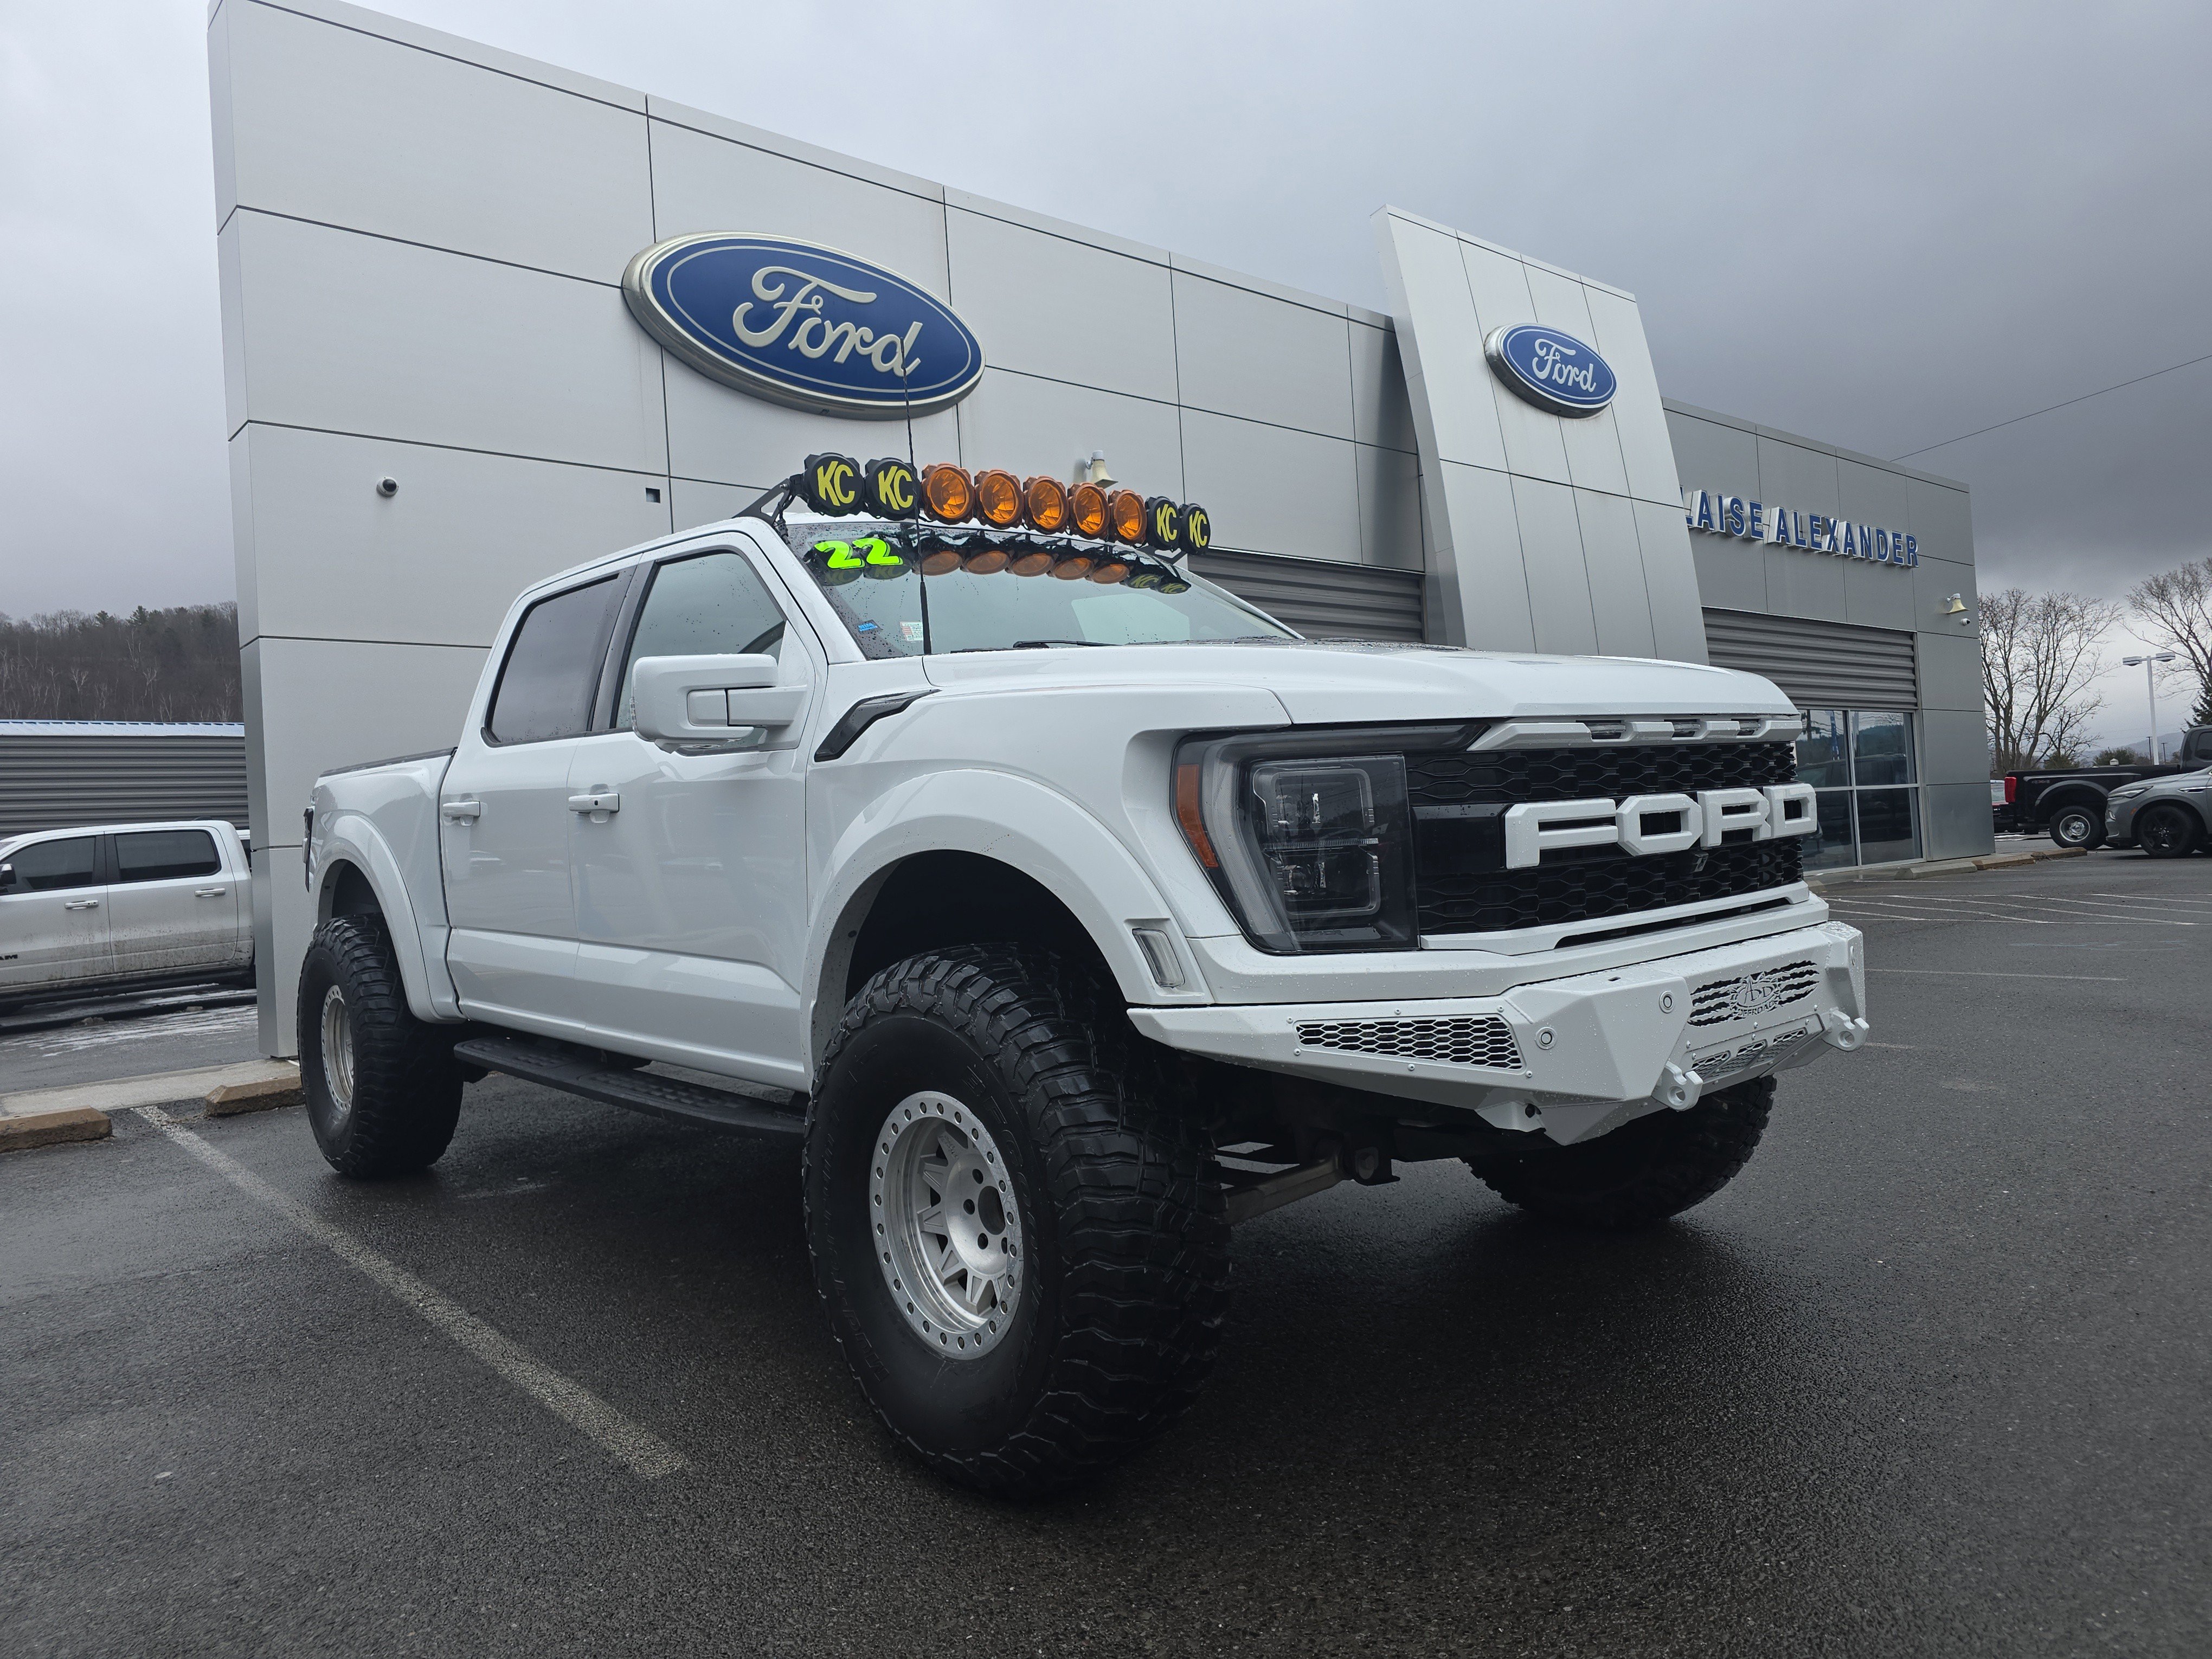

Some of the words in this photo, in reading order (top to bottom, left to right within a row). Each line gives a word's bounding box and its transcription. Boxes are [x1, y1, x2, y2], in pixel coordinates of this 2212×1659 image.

[732, 266, 923, 377] Ford
[1532, 338, 1596, 393] Ford
[817, 461, 855, 506] KC
[878, 466, 914, 511] KC
[1156, 504, 1178, 542] KC
[1189, 510, 1208, 548] KC
[1771, 506, 1919, 568] ALEXANDER
[814, 537, 904, 569] 22
[1505, 783, 1817, 869] FORD
